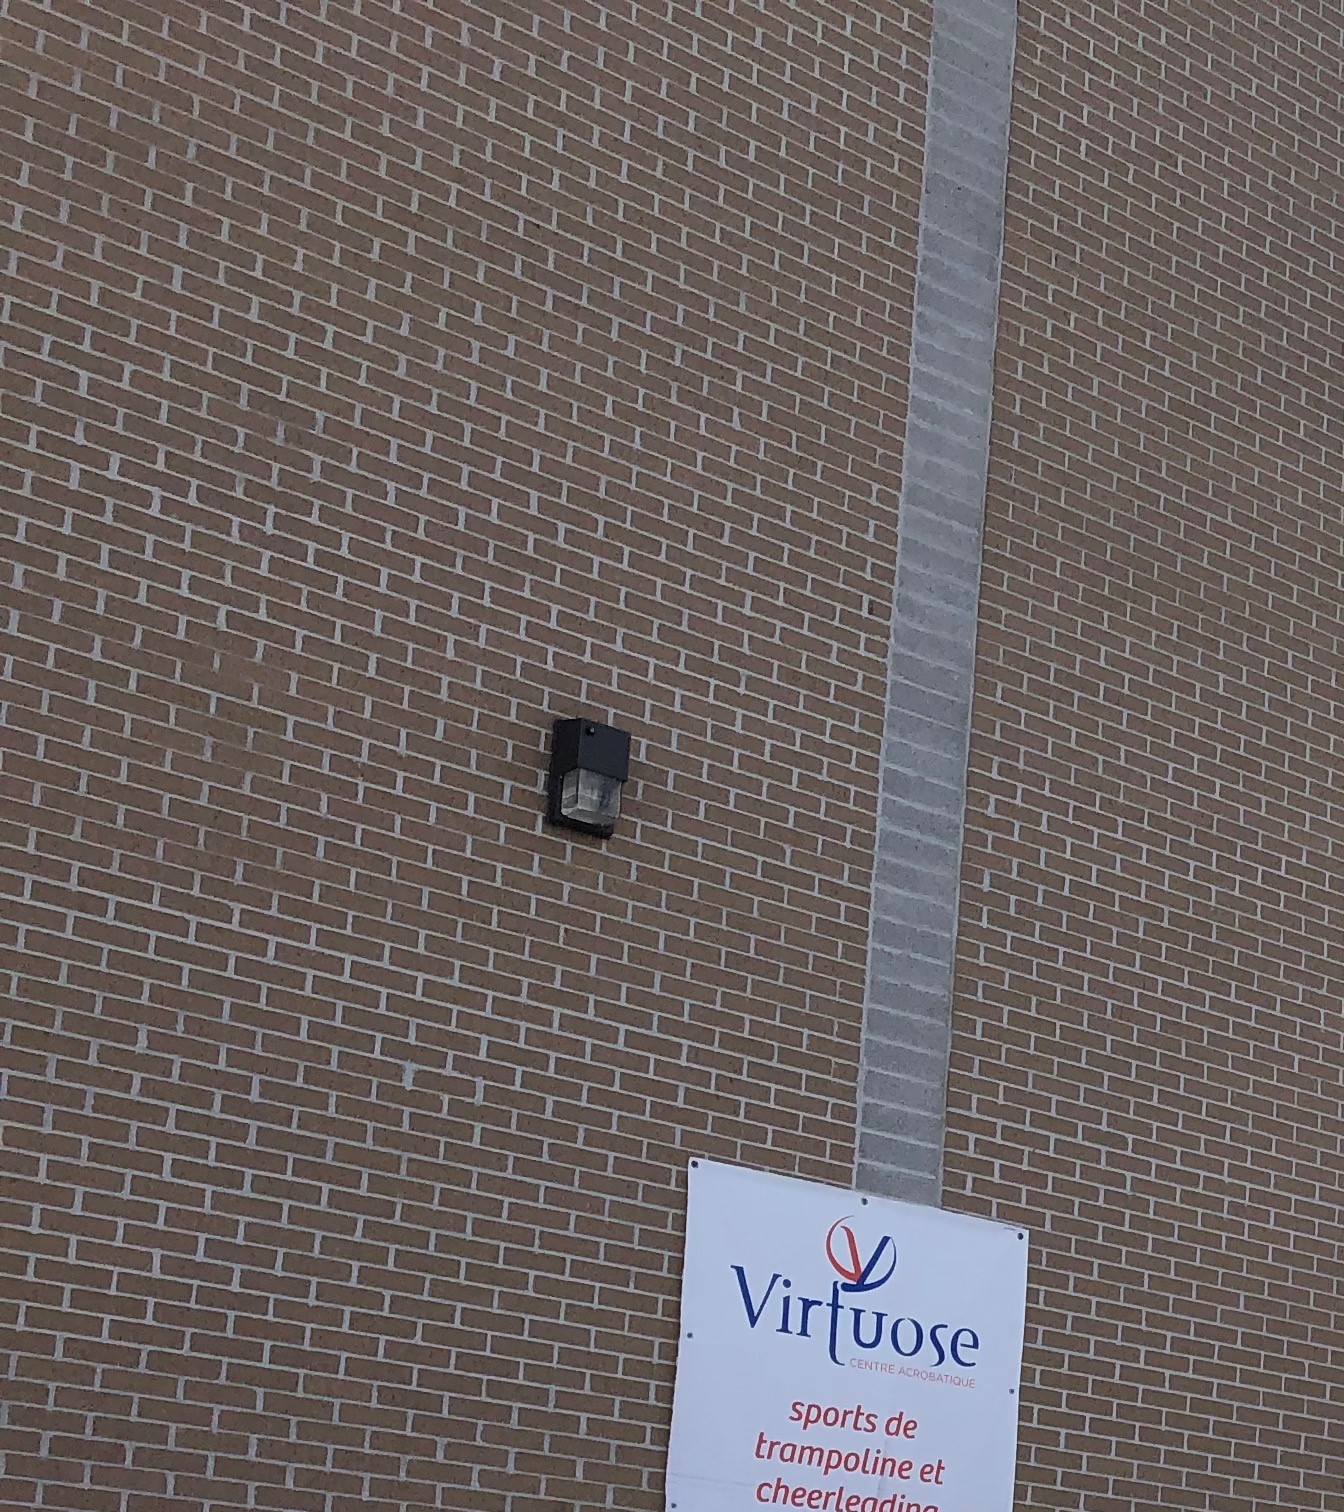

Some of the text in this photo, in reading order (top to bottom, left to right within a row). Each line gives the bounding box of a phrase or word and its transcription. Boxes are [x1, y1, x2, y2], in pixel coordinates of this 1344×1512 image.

[730, 1264, 980, 1368] Virtuose
[849, 1358, 976, 1389] CENTRE ACROBATIQUE
[788, 1401, 918, 1439] sports de
[755, 1432, 946, 1485] trampoline et
